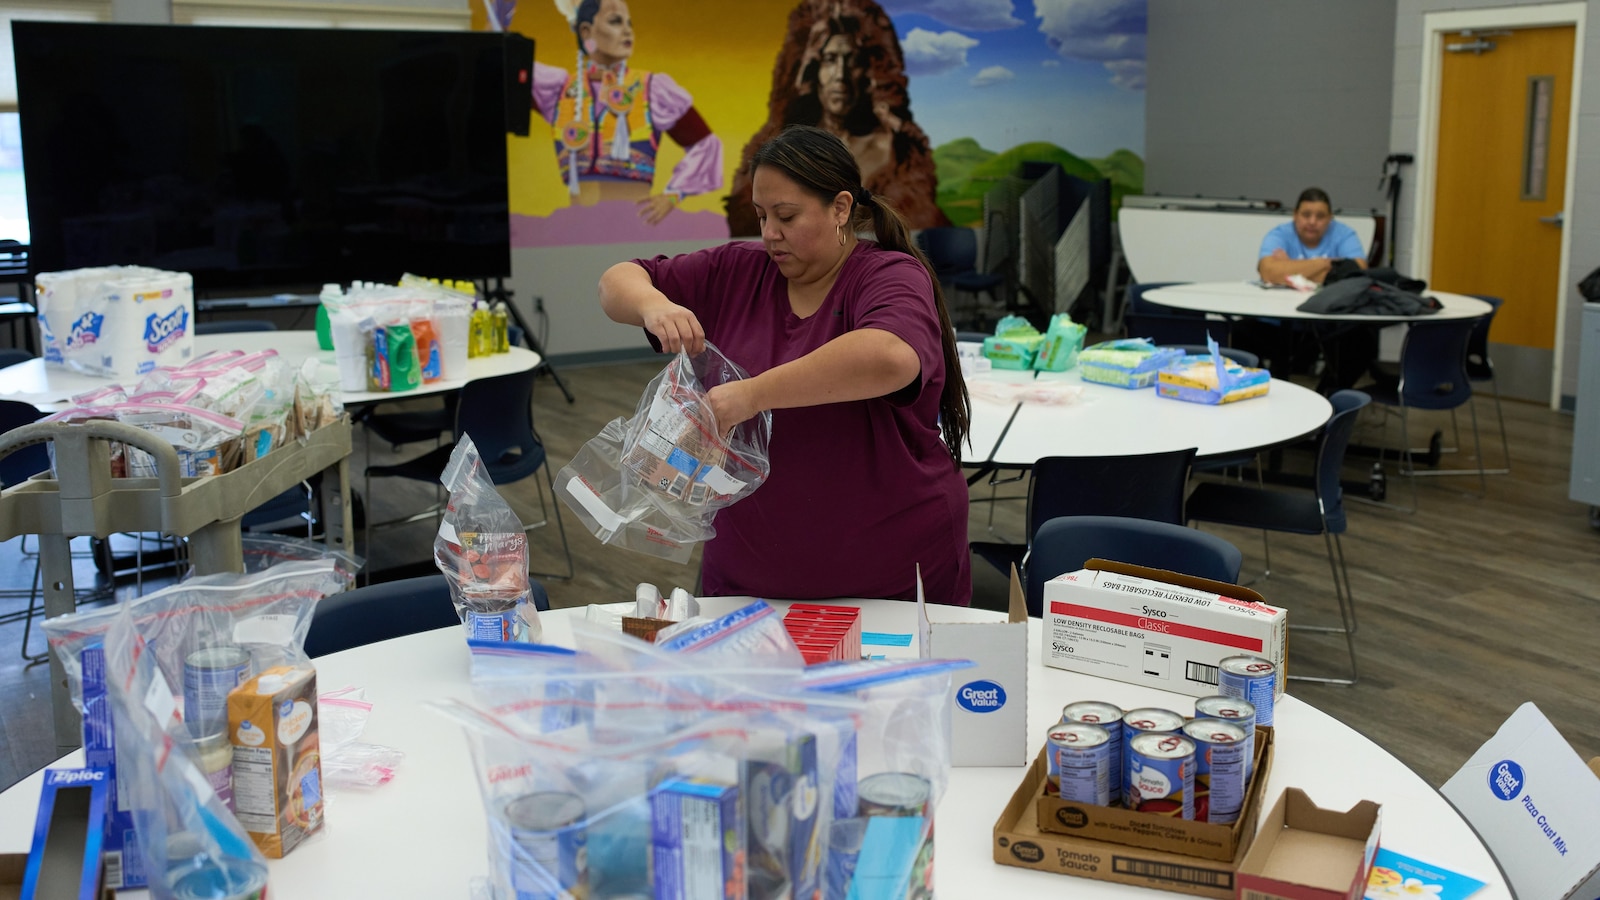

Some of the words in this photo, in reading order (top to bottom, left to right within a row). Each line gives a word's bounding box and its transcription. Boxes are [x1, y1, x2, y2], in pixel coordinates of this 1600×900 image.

[1102, 581, 1120, 590] BAGS
[1122, 584, 1162, 598] RECLOSABLE
[1164, 592, 1194, 604] DENSITY
[1194, 598, 1211, 607] LOW
[1142, 605, 1167, 618] Sysco
[1228, 605, 1258, 616] Sysco
[1068, 620, 1092, 629] DENSITY
[1092, 624, 1128, 637] RECLOSABLE
[1138, 617, 1170, 634] Classic
[1052, 642, 1074, 653] Sysco
[962, 688, 998, 700] Great
[55, 770, 104, 783] Ziploc
[1498, 763, 1520, 791] Great
[1138, 781, 1164, 794] Sauce
[1496, 775, 1511, 796] Value
[1129, 820, 1151, 829] Diced
[1152, 824, 1186, 834] Tomatoes
[1521, 795, 1539, 818] Pizza
[1537, 815, 1557, 840] Crust
[1552, 837, 1568, 856] Mix
[1110, 823, 1131, 832] Green
[1197, 838, 1222, 848] Onions
[1056, 848, 1100, 864] Tomato
[1060, 858, 1097, 872] Sauce
